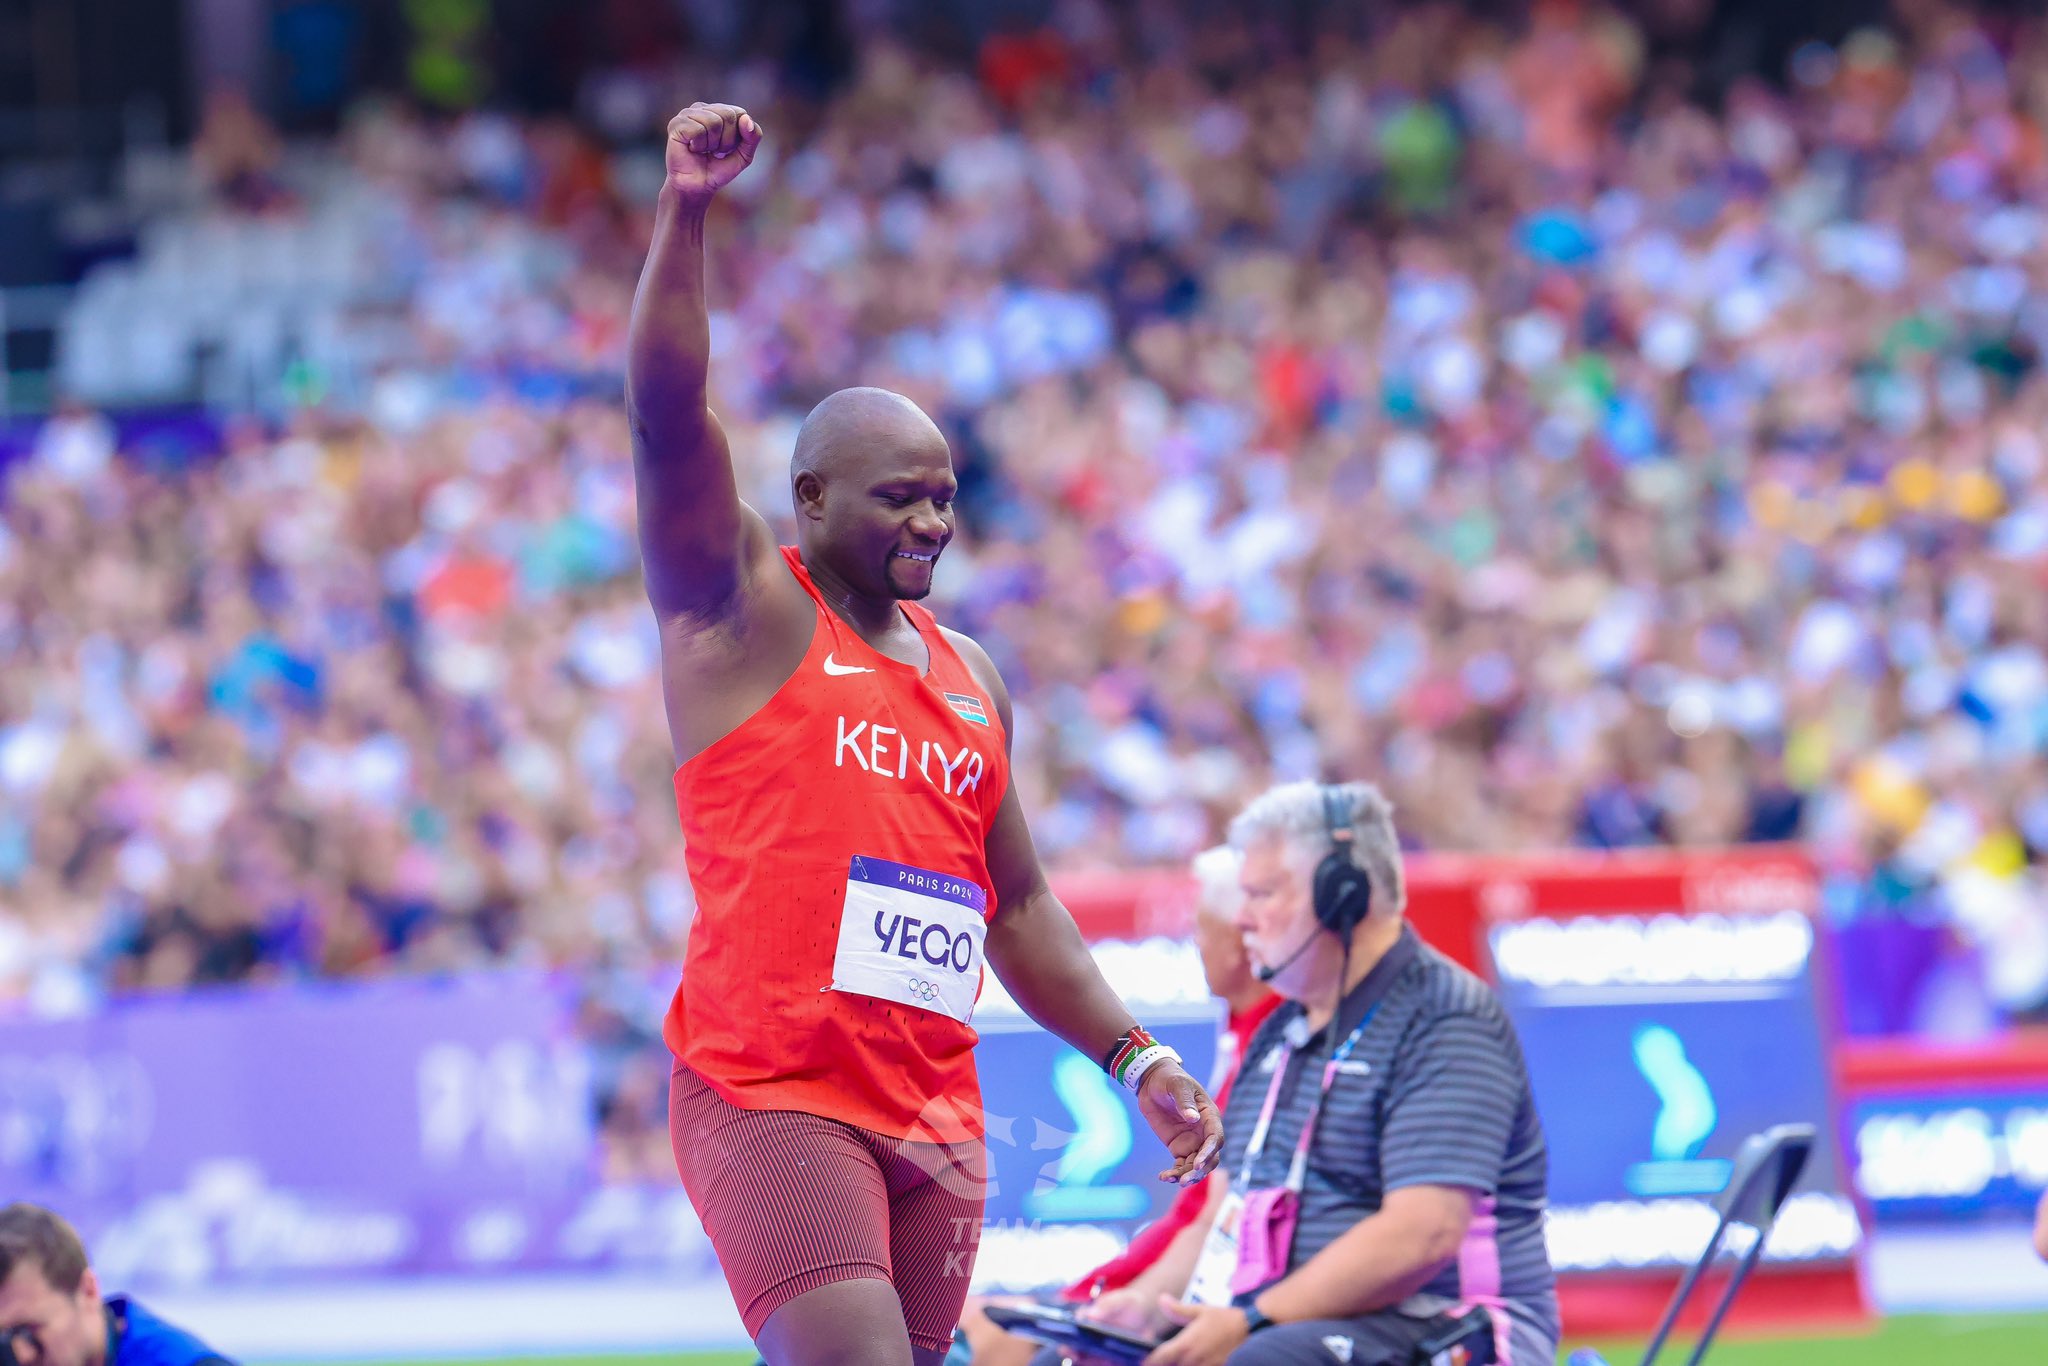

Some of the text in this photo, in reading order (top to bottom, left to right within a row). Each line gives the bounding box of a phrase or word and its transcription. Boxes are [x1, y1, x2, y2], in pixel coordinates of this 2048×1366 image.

[835, 715, 984, 797] KENYA
[943, 882, 972, 900] 2024
[874, 910, 973, 973] YEGO
